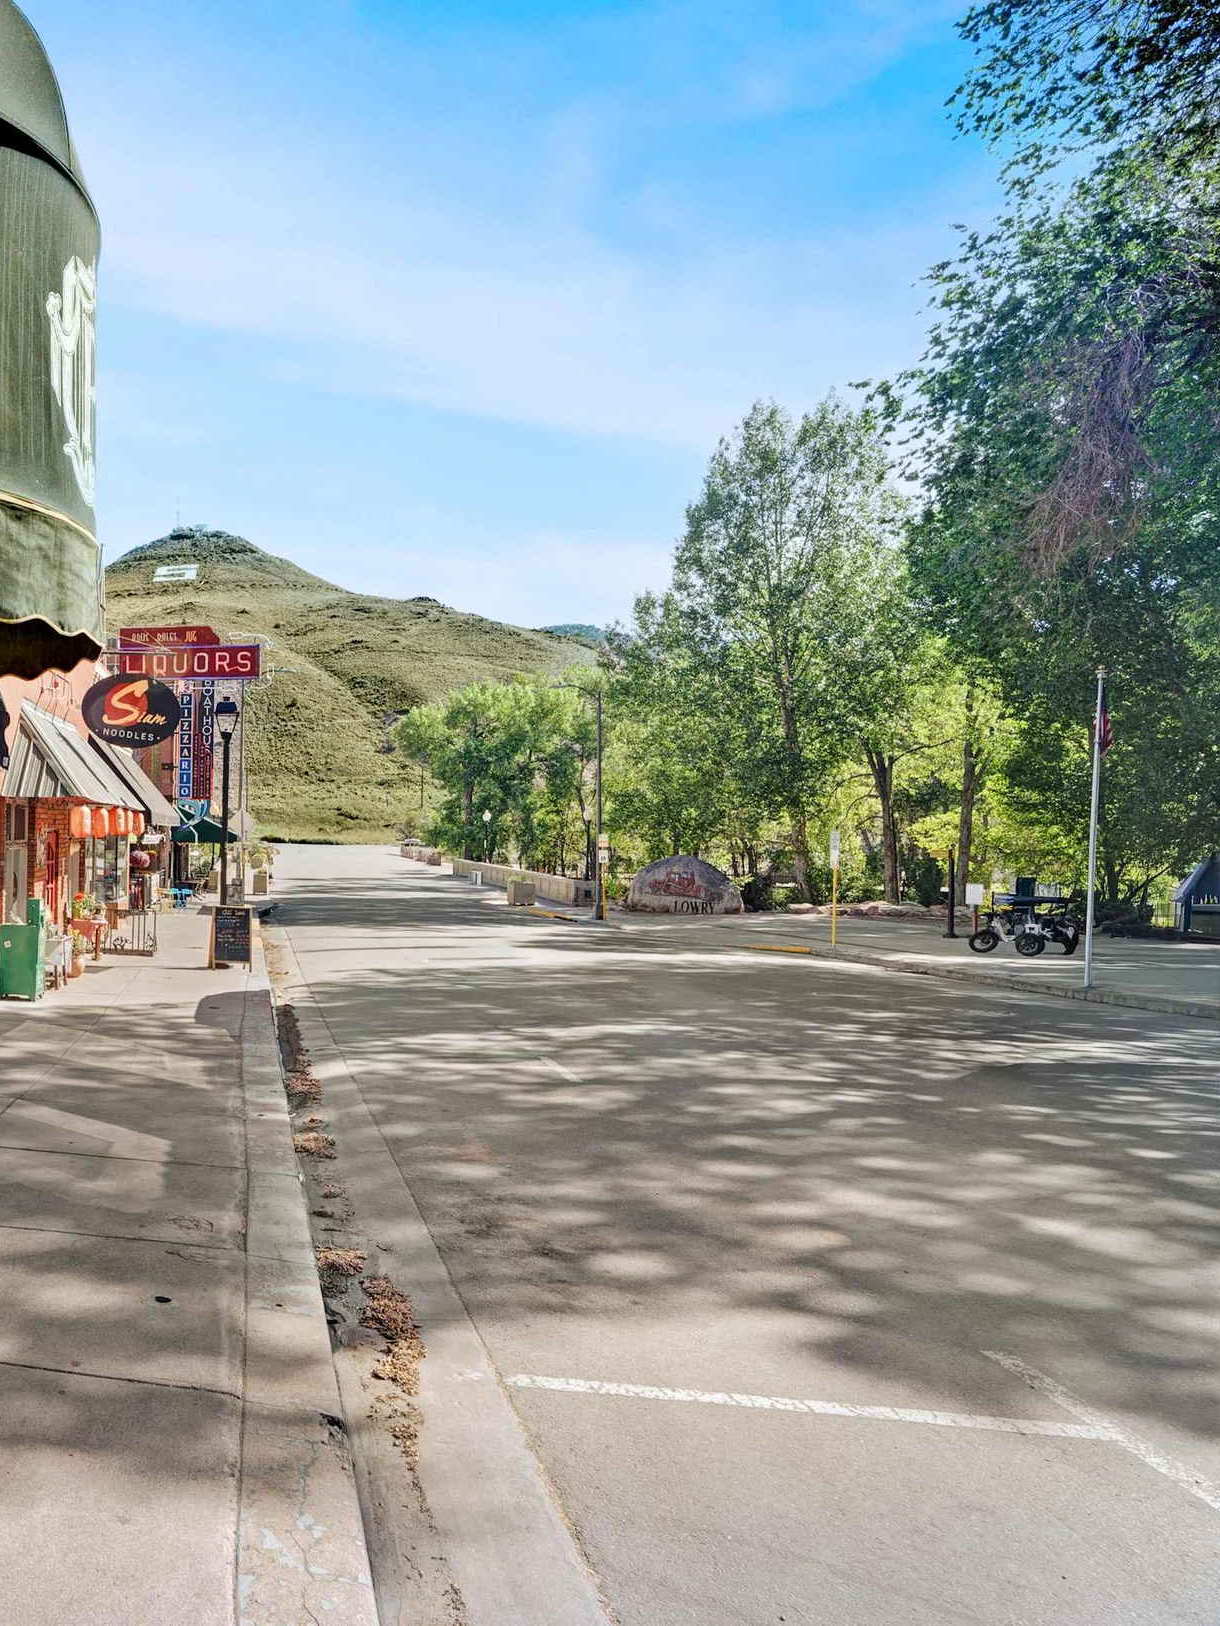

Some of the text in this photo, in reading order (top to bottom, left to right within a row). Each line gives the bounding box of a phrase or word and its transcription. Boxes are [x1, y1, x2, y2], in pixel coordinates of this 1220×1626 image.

[184, 630, 198, 643] JUG
[125, 651, 252, 677] LIQUORS
[102, 679, 167, 726] Siam
[102, 727, 155, 742] NOODLES
[180, 694, 190, 796] PIZZARIO
[674, 900, 717, 915] LOWRY
